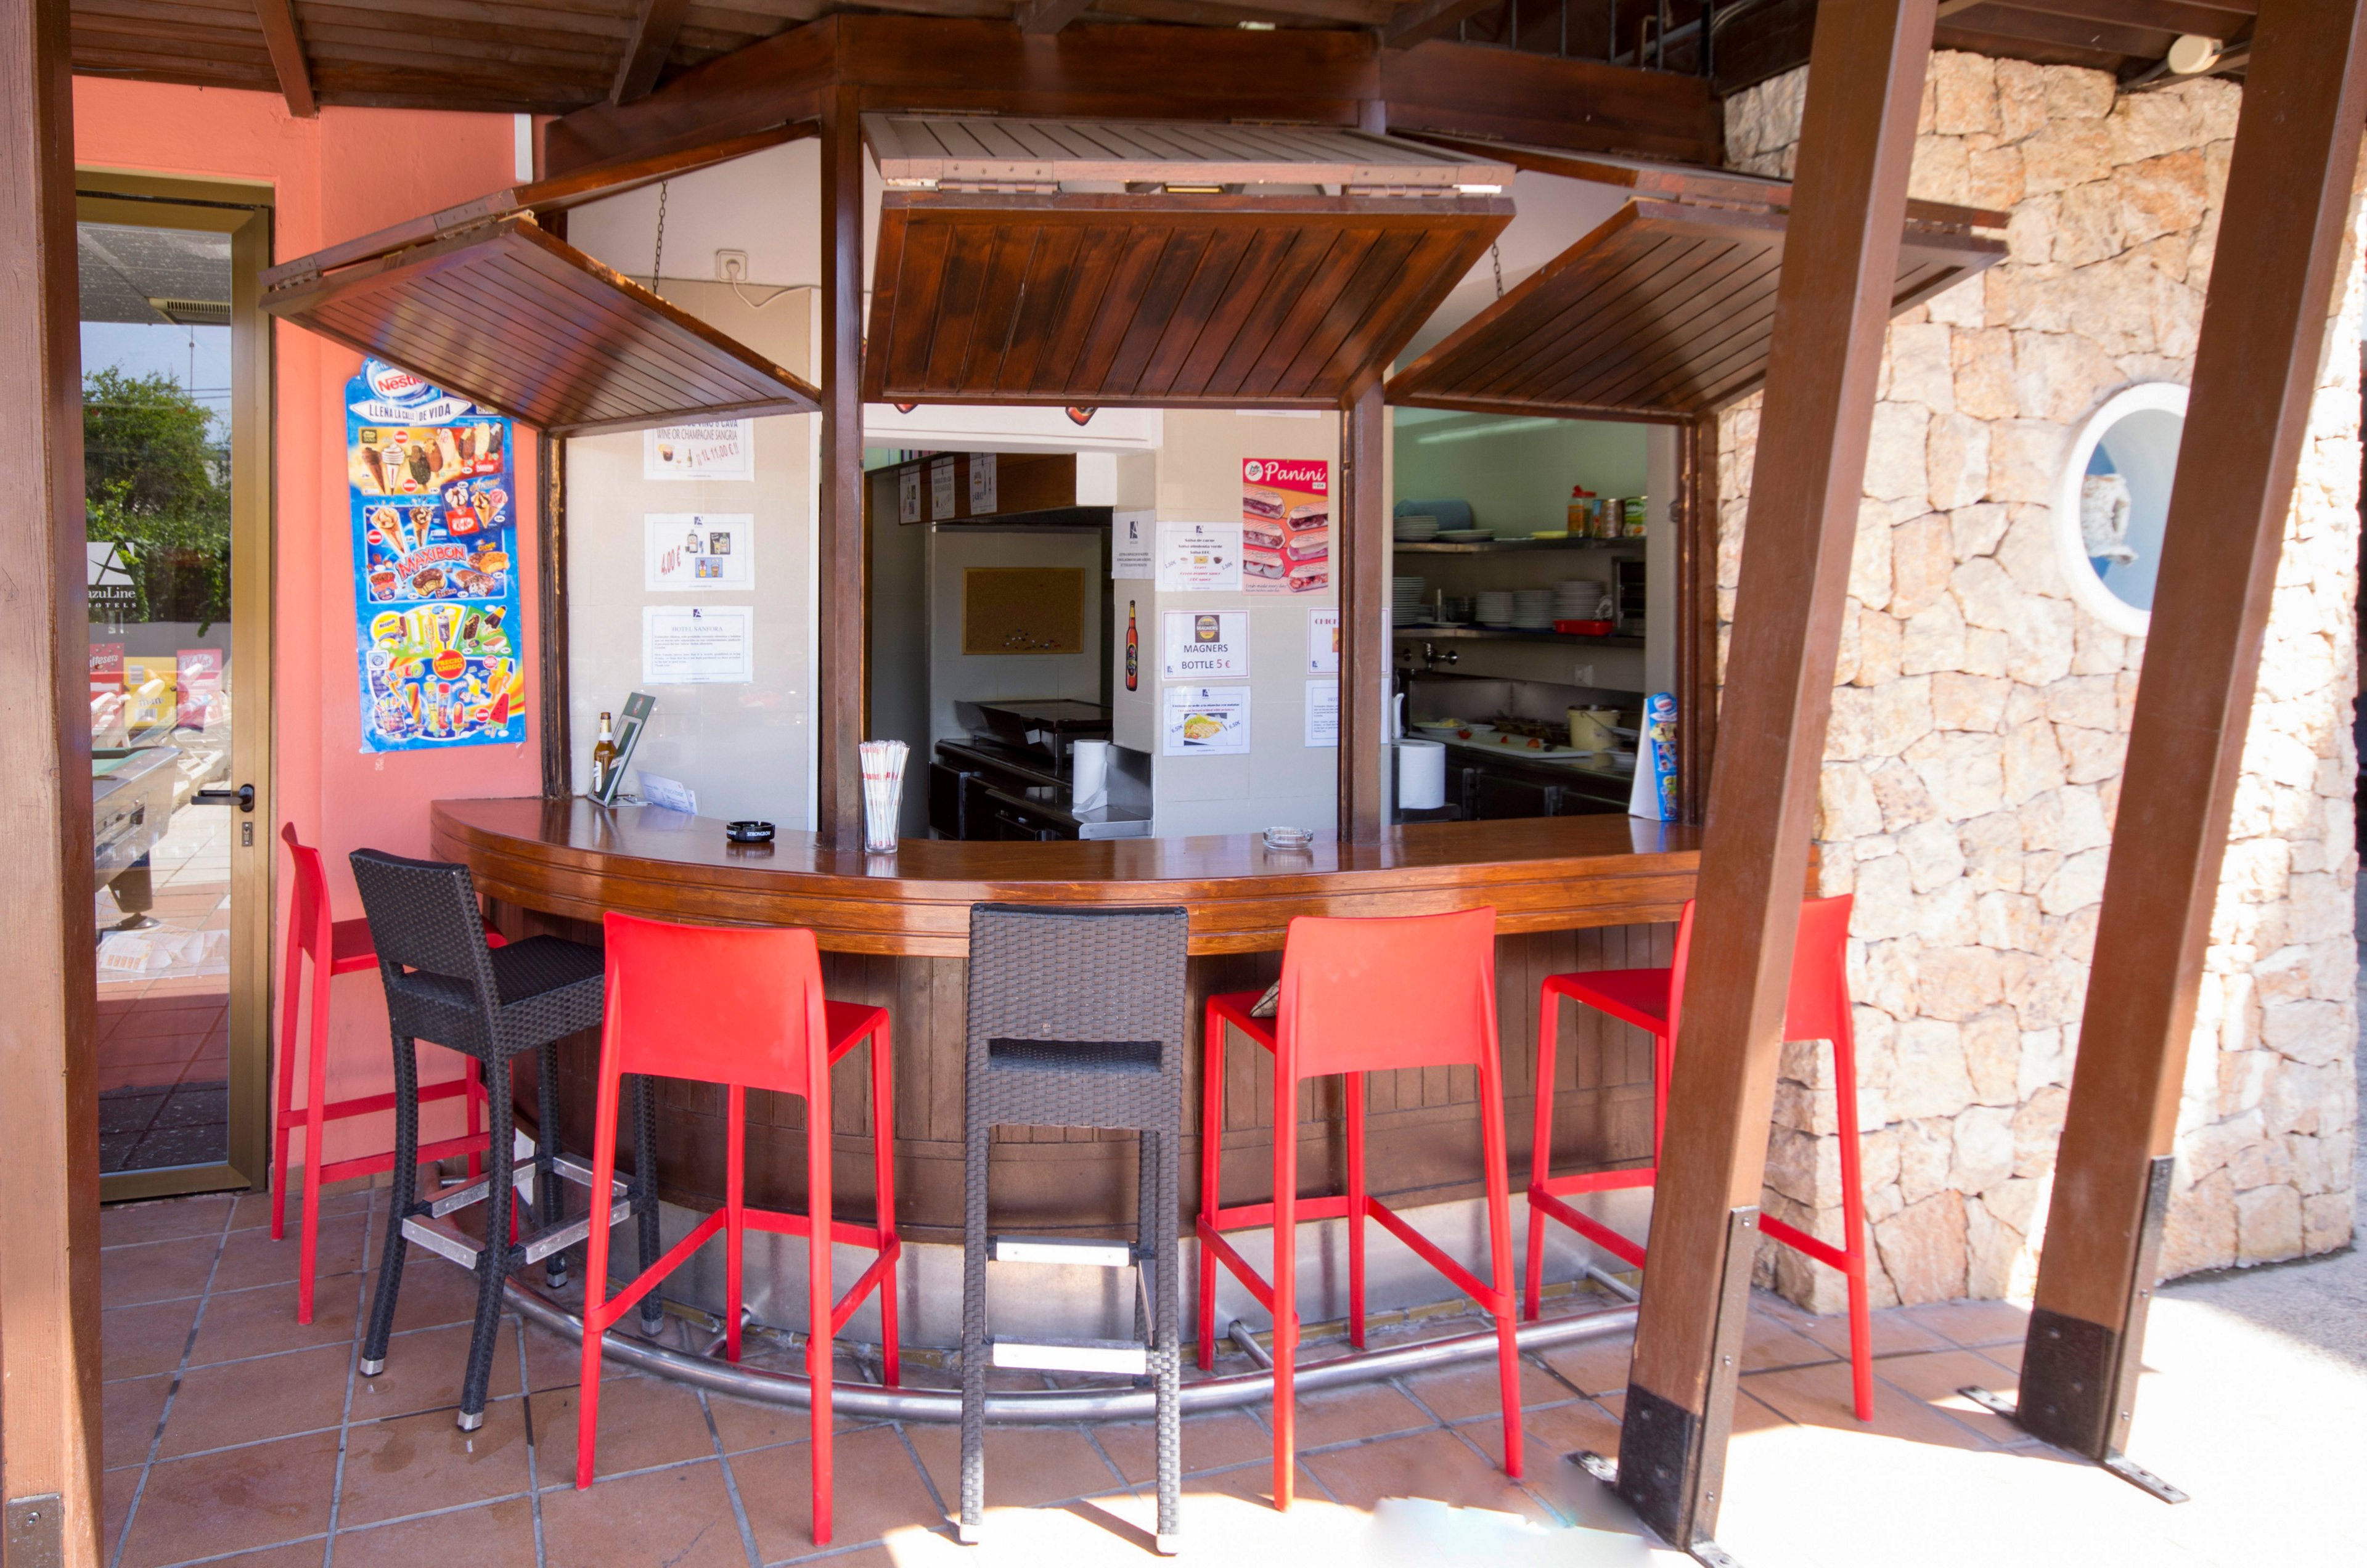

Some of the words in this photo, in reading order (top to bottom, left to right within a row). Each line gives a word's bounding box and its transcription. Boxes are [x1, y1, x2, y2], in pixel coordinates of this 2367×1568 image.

[369, 404, 393, 417] LLENA
[394, 408, 401, 418] LA
[402, 409, 415, 420] CALLE
[419, 410, 427, 421] DE
[430, 403, 452, 419] VIDA
[656, 428, 671, 439] WINE
[672, 428, 680, 439] OR
[681, 429, 714, 439] CHAMPAGNE
[1265, 461, 1327, 481] Panini
[396, 545, 465, 580] MAXIBON
[1184, 644, 1228, 653] MAGNERS
[89, 653, 118, 668] ltesers
[436, 658, 462, 666] PRECIO
[1182, 661, 1214, 669] BOTTLE
[1217, 659, 1222, 669] 5
[1225, 660, 1230, 668] €
[437, 664, 463, 672] AMIGO
